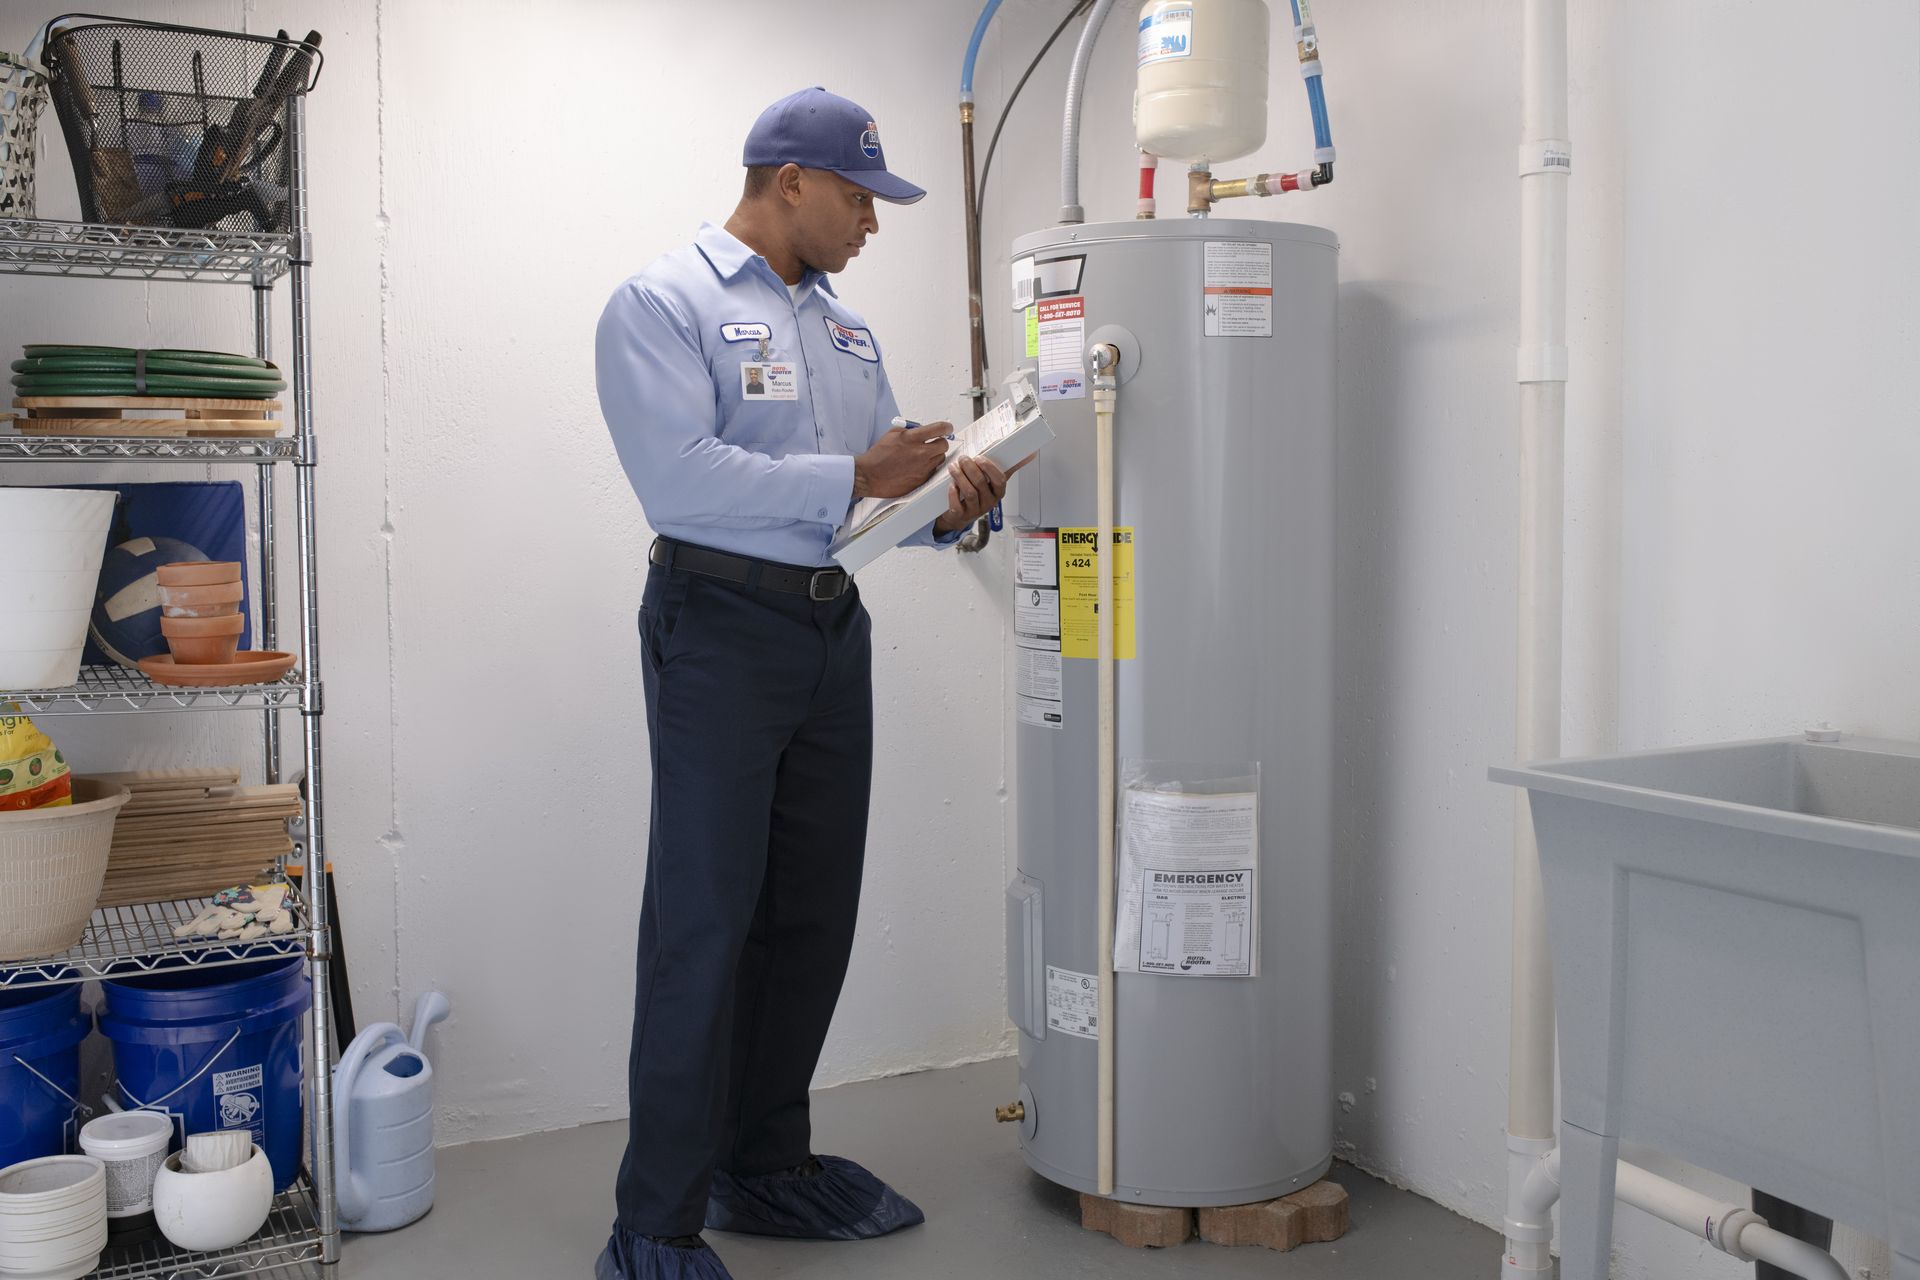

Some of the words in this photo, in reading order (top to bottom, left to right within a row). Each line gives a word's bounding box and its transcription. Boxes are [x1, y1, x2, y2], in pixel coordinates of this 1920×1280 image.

[1060, 301, 1081, 309] SERVICE
[734, 327, 763, 337] Marcus
[1071, 558, 1091, 568] 424
[1154, 873, 1244, 884] EMERGENCY
[225, 1066, 260, 1078] WARNING
[225, 1073, 260, 1085] AVERTISSEMENT
[225, 1080, 260, 1092] ADVERTENCIA
